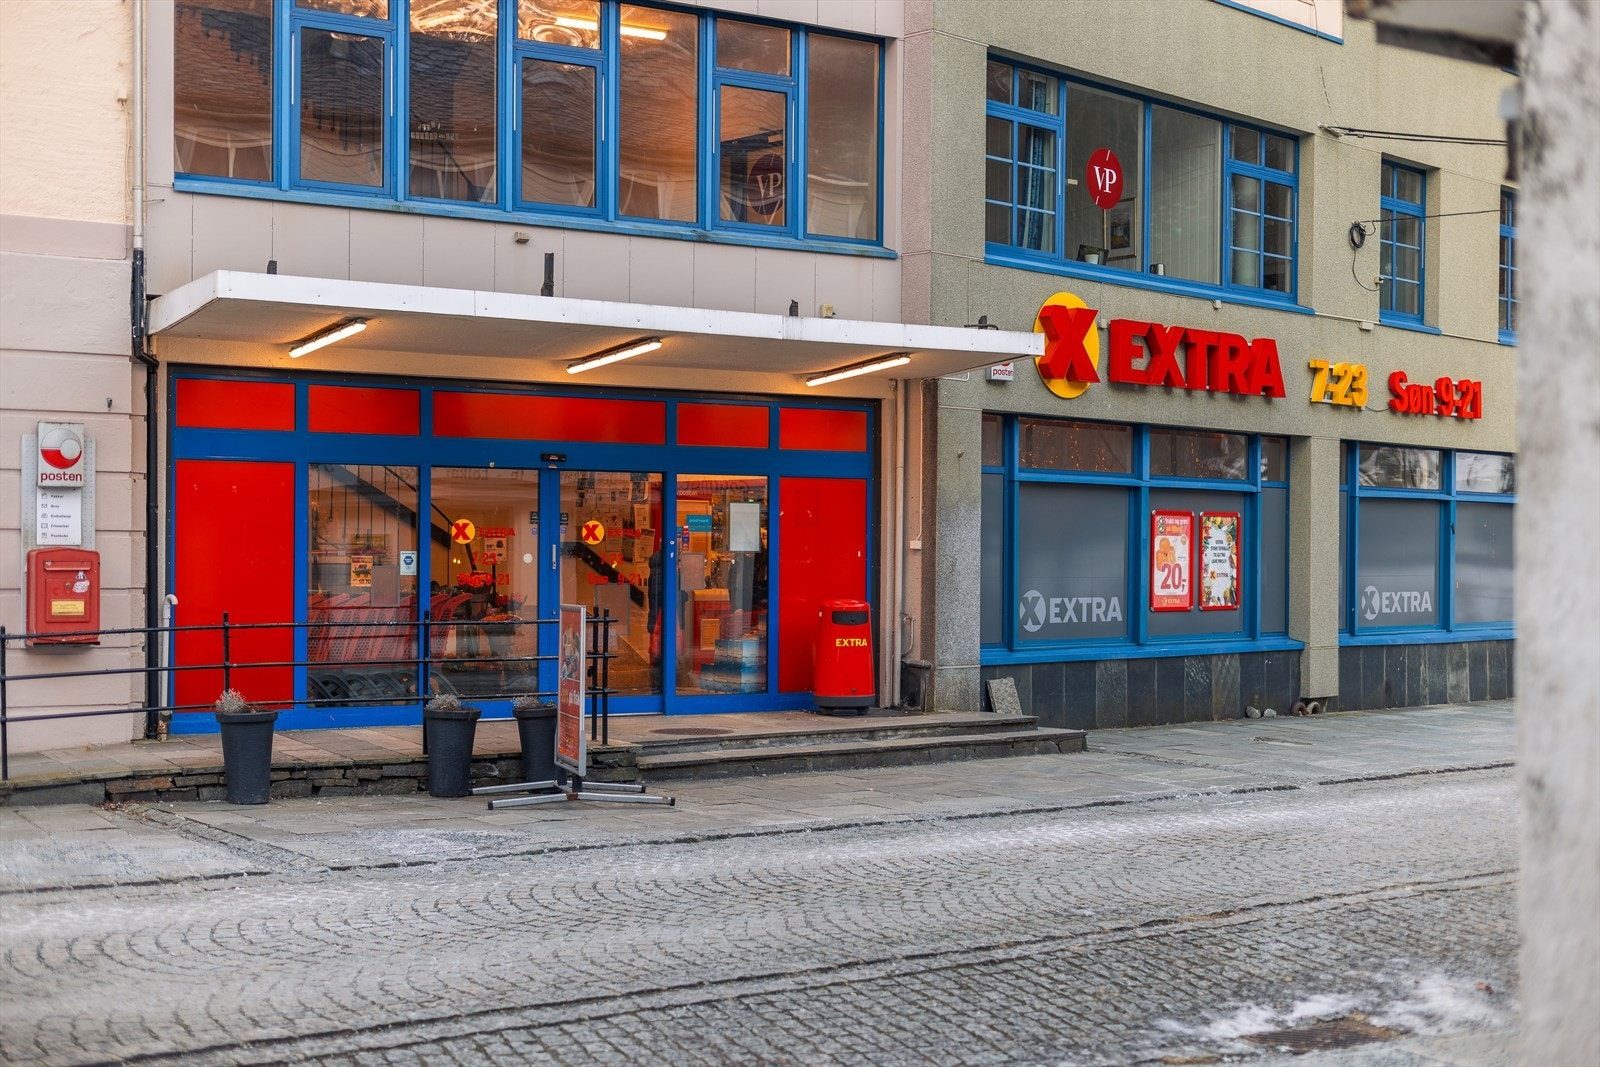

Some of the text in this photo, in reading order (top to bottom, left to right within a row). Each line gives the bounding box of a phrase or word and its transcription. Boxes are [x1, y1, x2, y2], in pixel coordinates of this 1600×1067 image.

[756, 172, 782, 198] VP
[1093, 165, 1117, 193] VP
[1109, 319, 1286, 398] EXTRA
[1309, 359, 1369, 407] 7-23
[1388, 371, 1482, 419] Søn 9-21
[40, 471, 82, 483] posten
[1049, 597, 1123, 623] EXTRA
[1382, 591, 1432, 613] EXTRA
[835, 638, 868, 647] EXTRA
